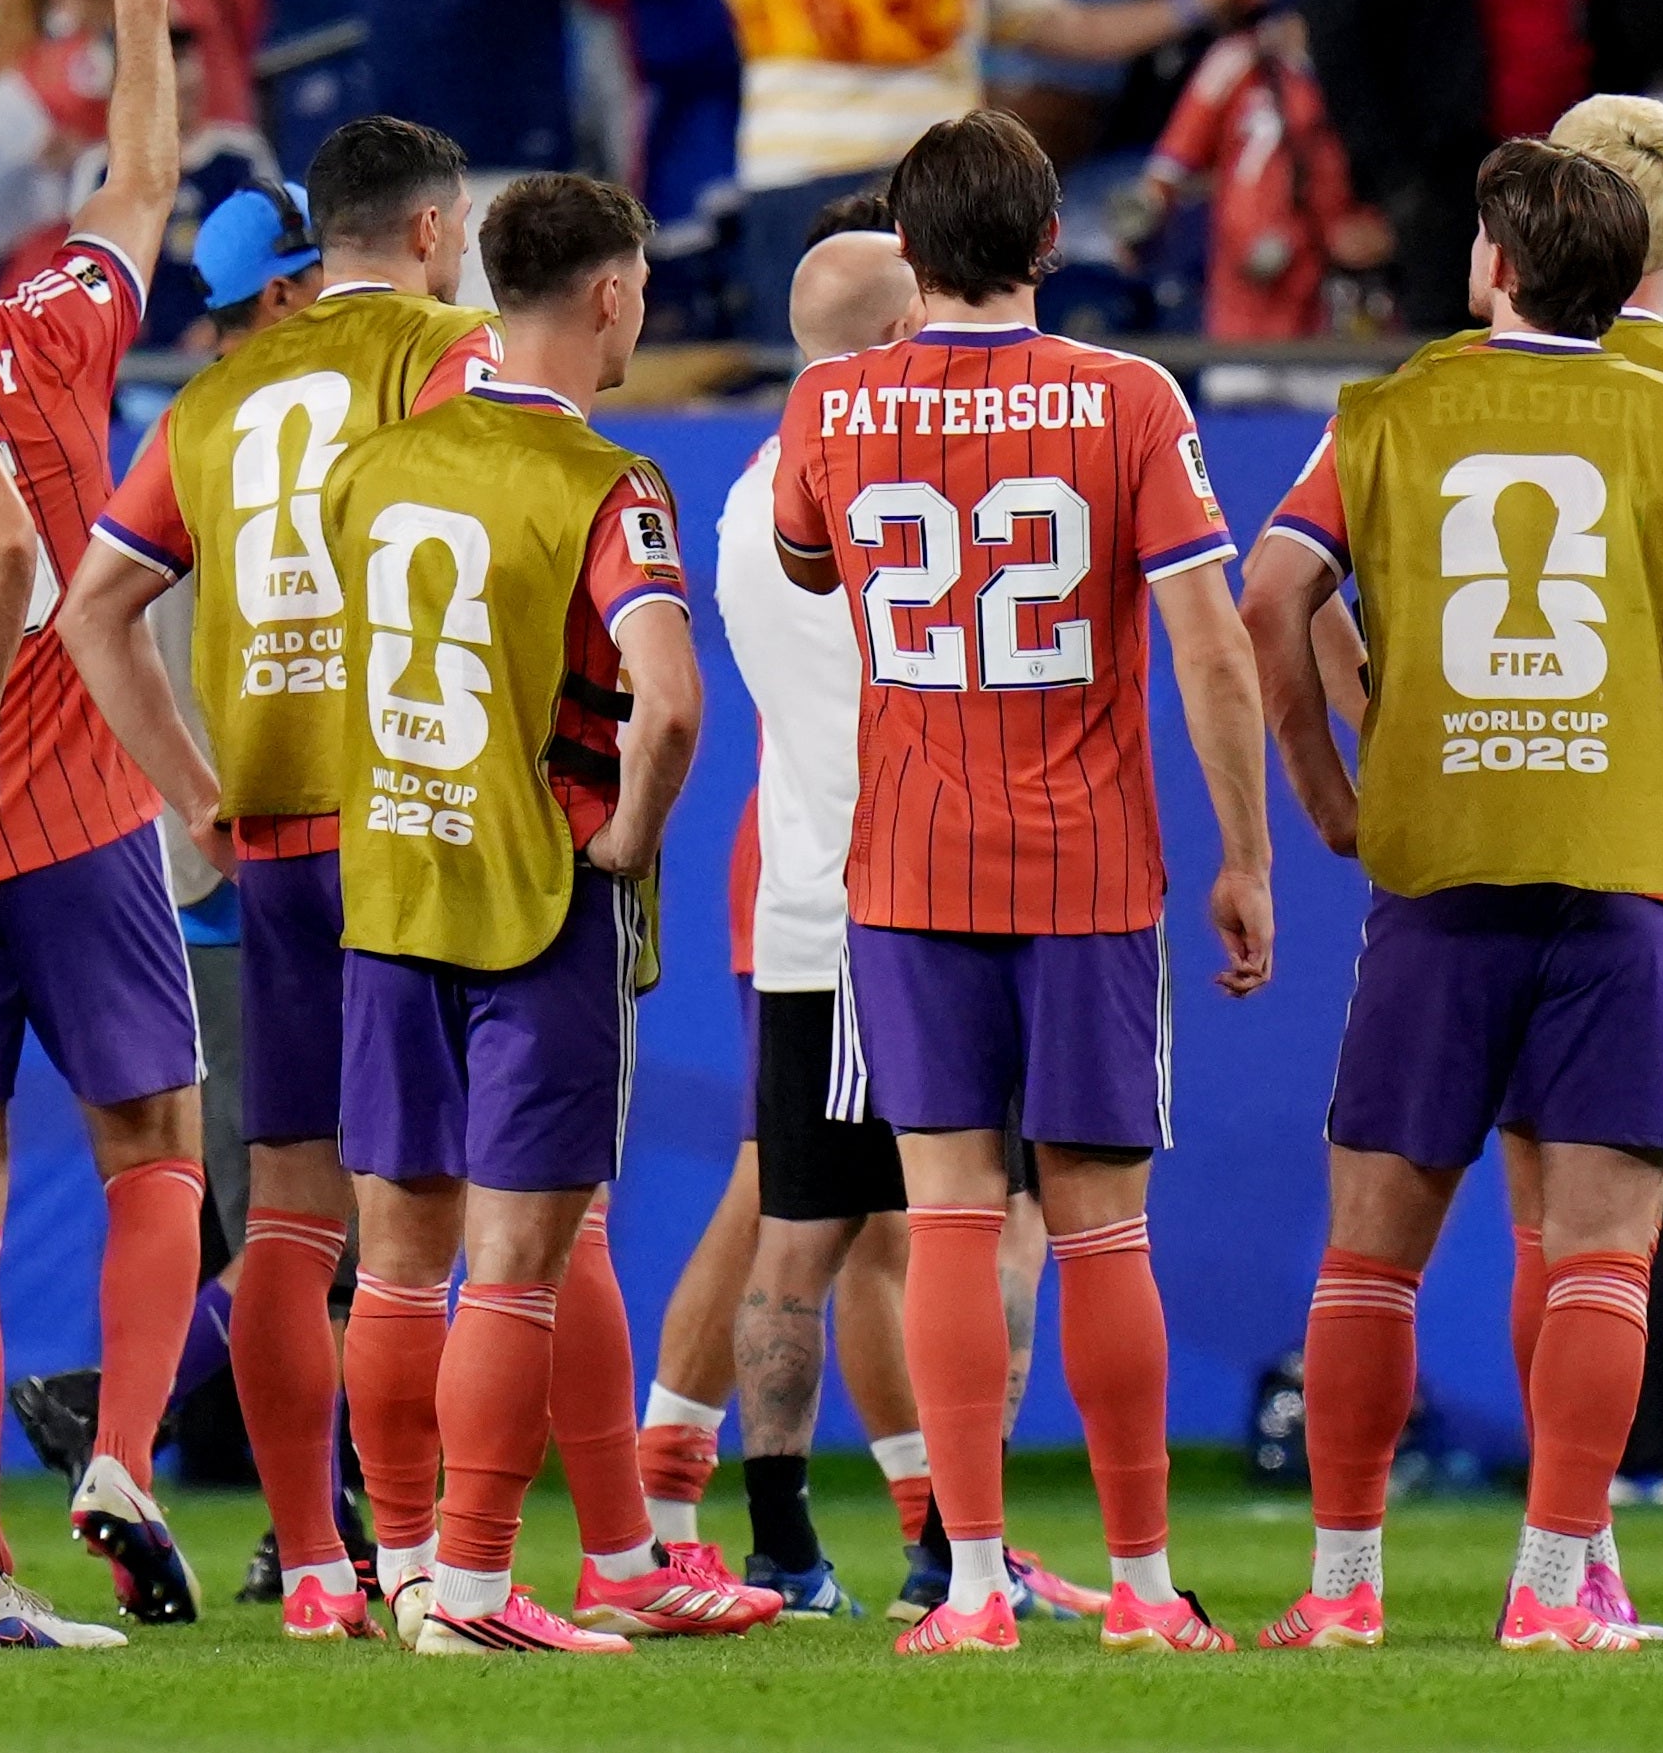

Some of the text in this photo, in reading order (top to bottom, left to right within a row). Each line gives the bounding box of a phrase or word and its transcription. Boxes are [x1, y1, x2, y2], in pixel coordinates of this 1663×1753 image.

[821, 383, 1107, 438] PATTERSON
[264, 570, 318, 597] IFA
[846, 477, 1095, 693] 22
[310, 628, 343, 652] CU
[240, 655, 348, 700] 026
[1490, 653, 1564, 678] FIFA
[382, 709, 446, 745] FIFA
[1442, 709, 1609, 734] WORLD CUP
[1442, 737, 1609, 775] 2026
[425, 779, 478, 808] CUP
[367, 795, 475, 846] 2026
